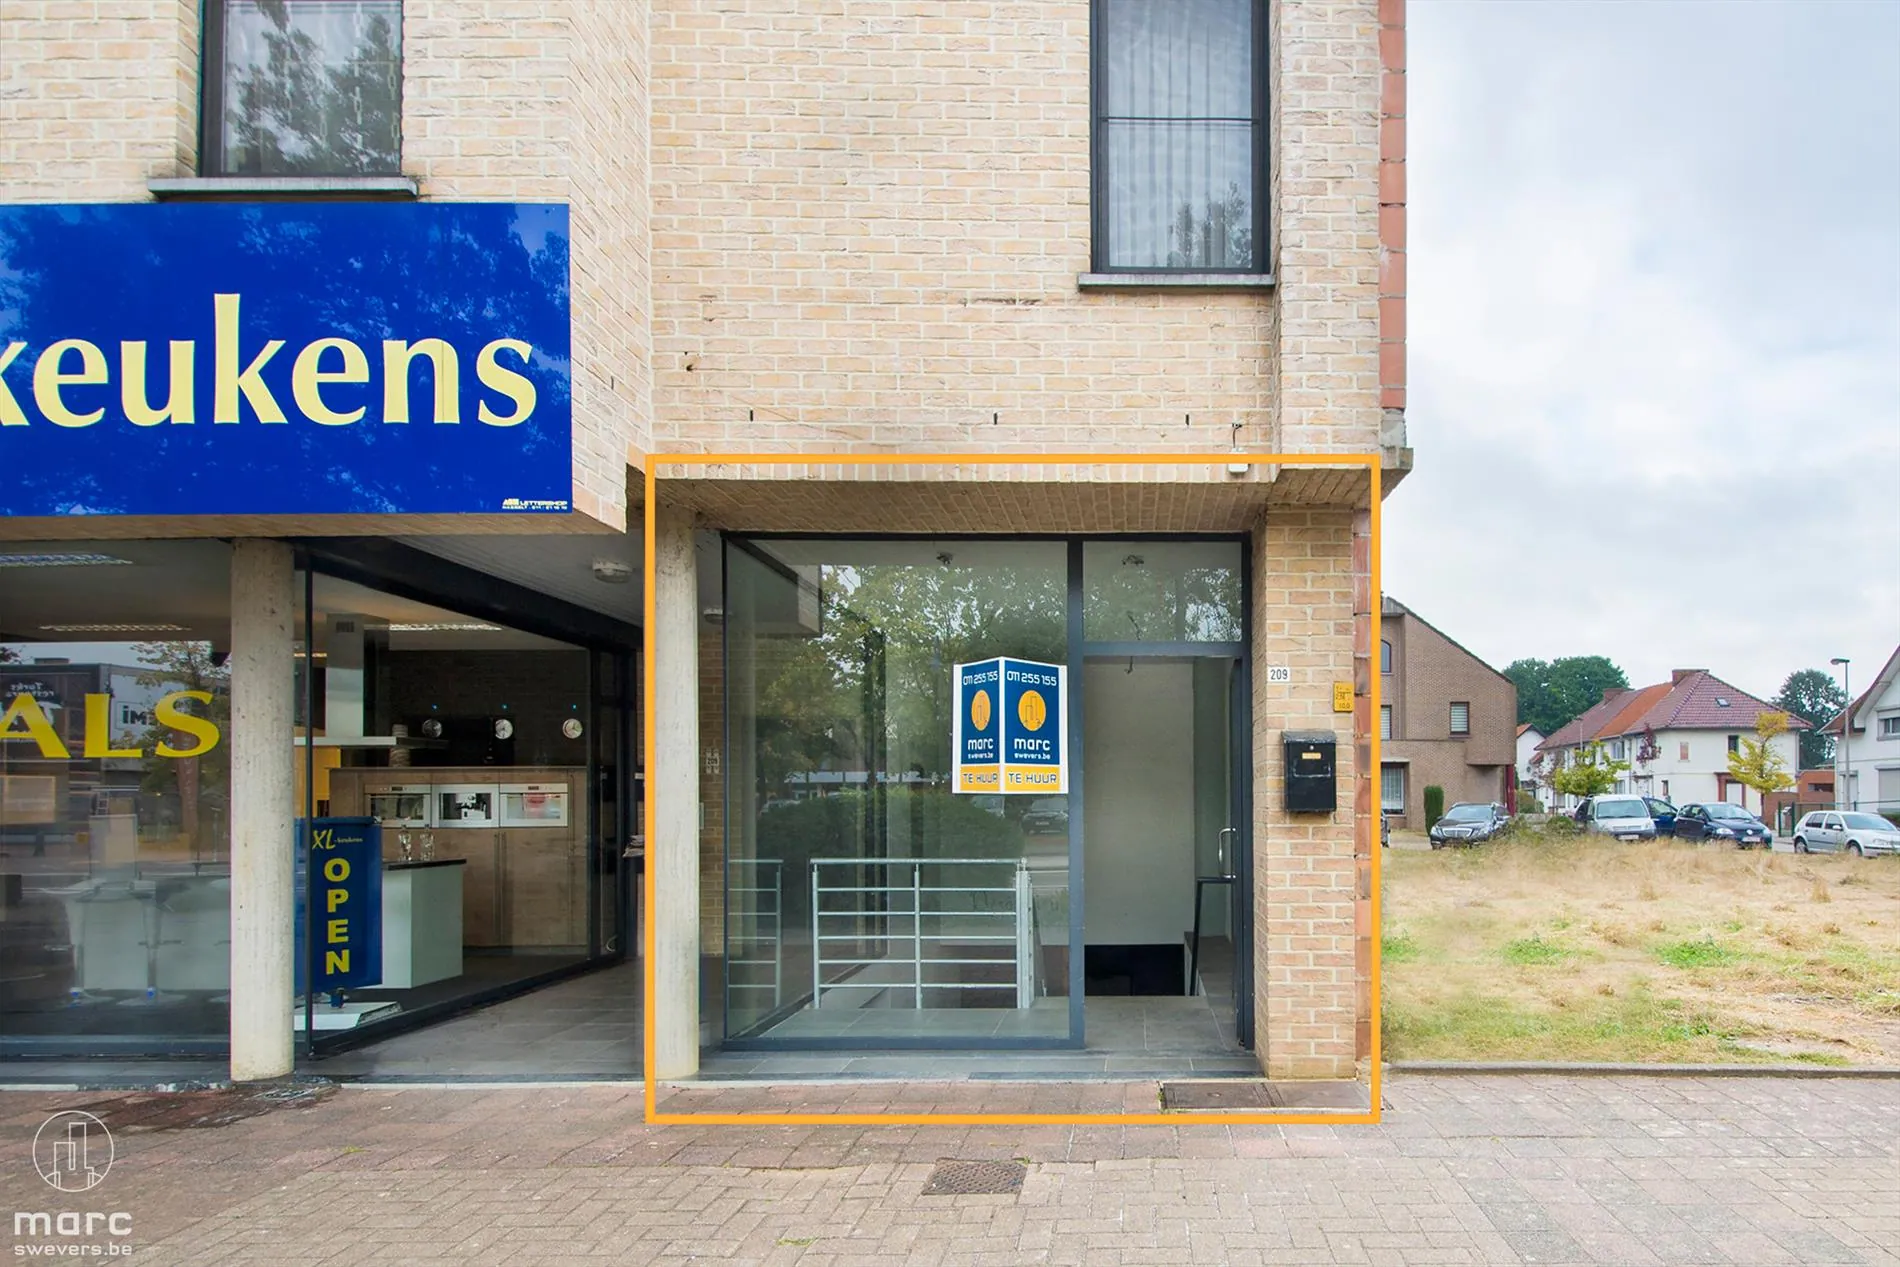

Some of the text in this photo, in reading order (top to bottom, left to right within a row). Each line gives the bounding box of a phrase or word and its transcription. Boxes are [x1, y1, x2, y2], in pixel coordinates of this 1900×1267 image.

[974, 673, 986, 683] 255
[1021, 673, 1040, 684] 255
[1041, 675, 1057, 686] 155
[1270, 669, 1288, 680] 209
[0, 690, 220, 758] ALS
[968, 739, 994, 751] marc
[1014, 739, 1050, 751] marc
[963, 773, 998, 783] TE HUUR
[1008, 773, 1057, 783] TE HUUR
[324, 858, 350, 975] OPEN
